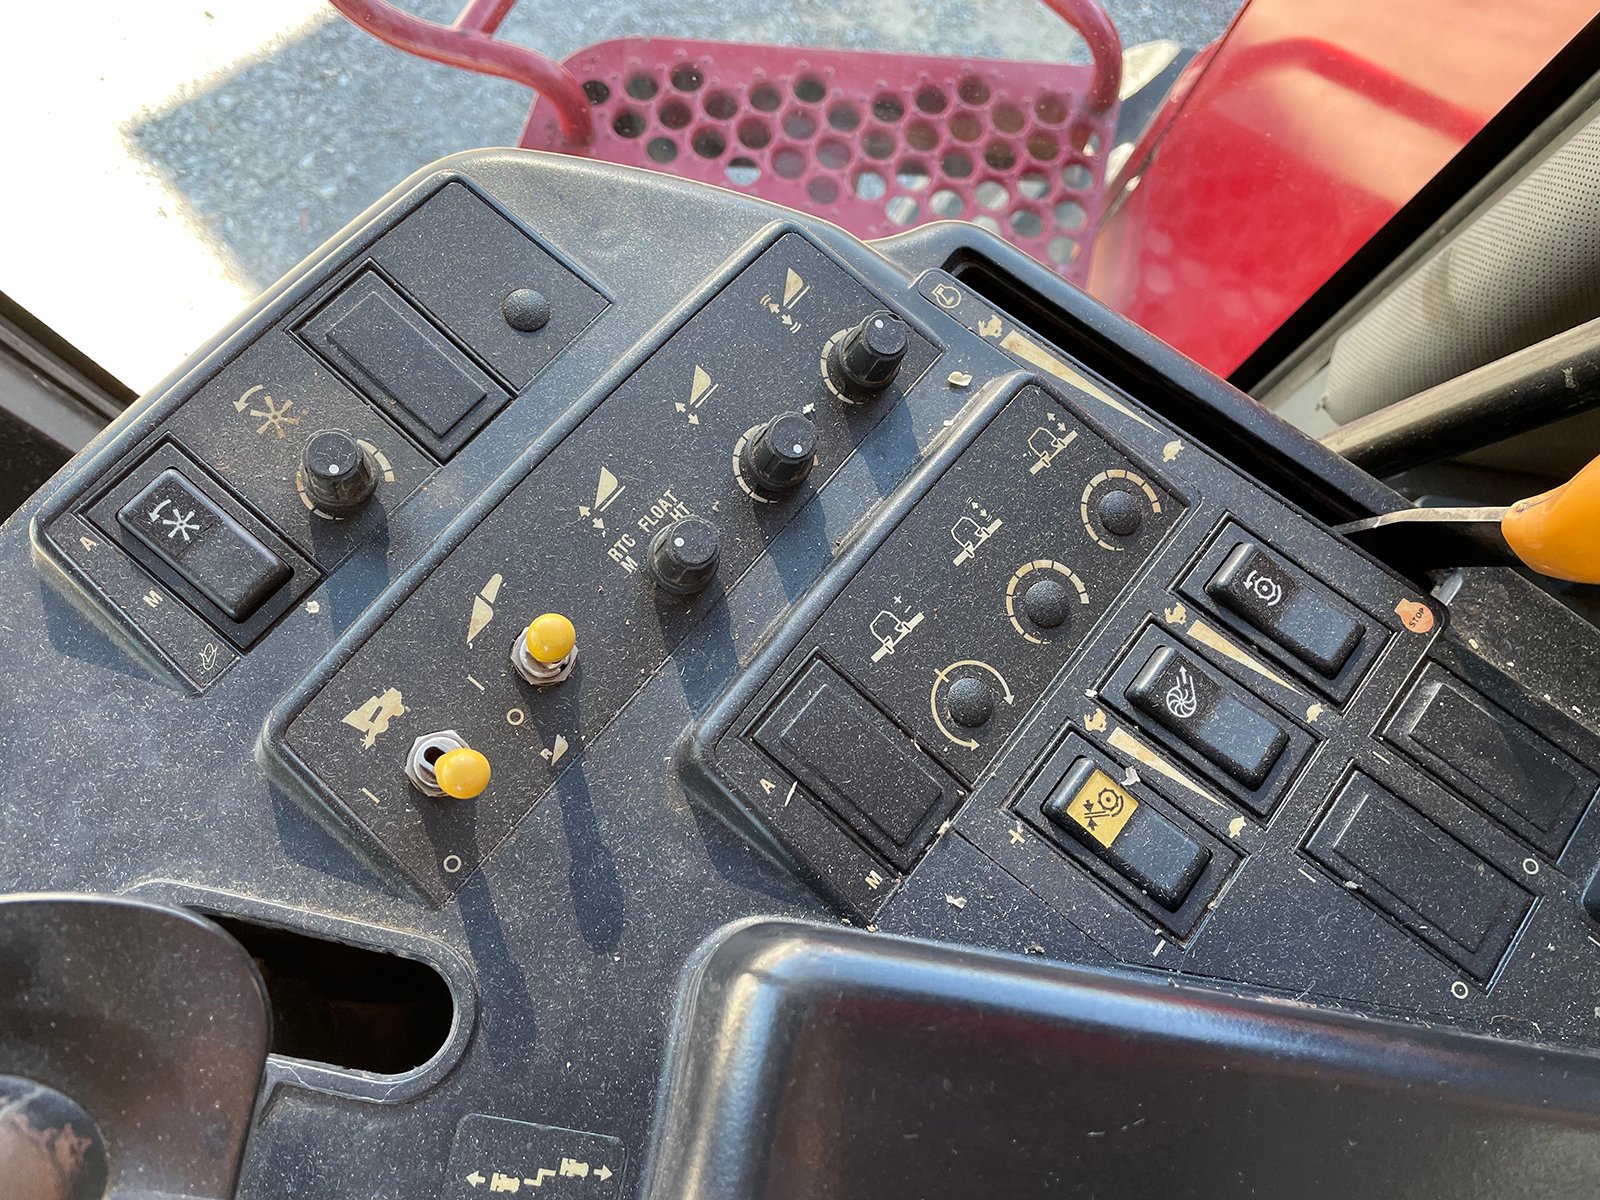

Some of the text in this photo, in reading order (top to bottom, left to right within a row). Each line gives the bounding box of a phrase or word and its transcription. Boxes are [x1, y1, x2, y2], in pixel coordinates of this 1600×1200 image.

[637, 489, 679, 532] FLOAT
[79, 536, 97, 552] A
[607, 533, 636, 562] RTC
[620, 555, 638, 574] M
[142, 589, 164, 609] M
[1408, 607, 1425, 628] STOP
[759, 778, 776, 795] A
[864, 869, 883, 890] M
